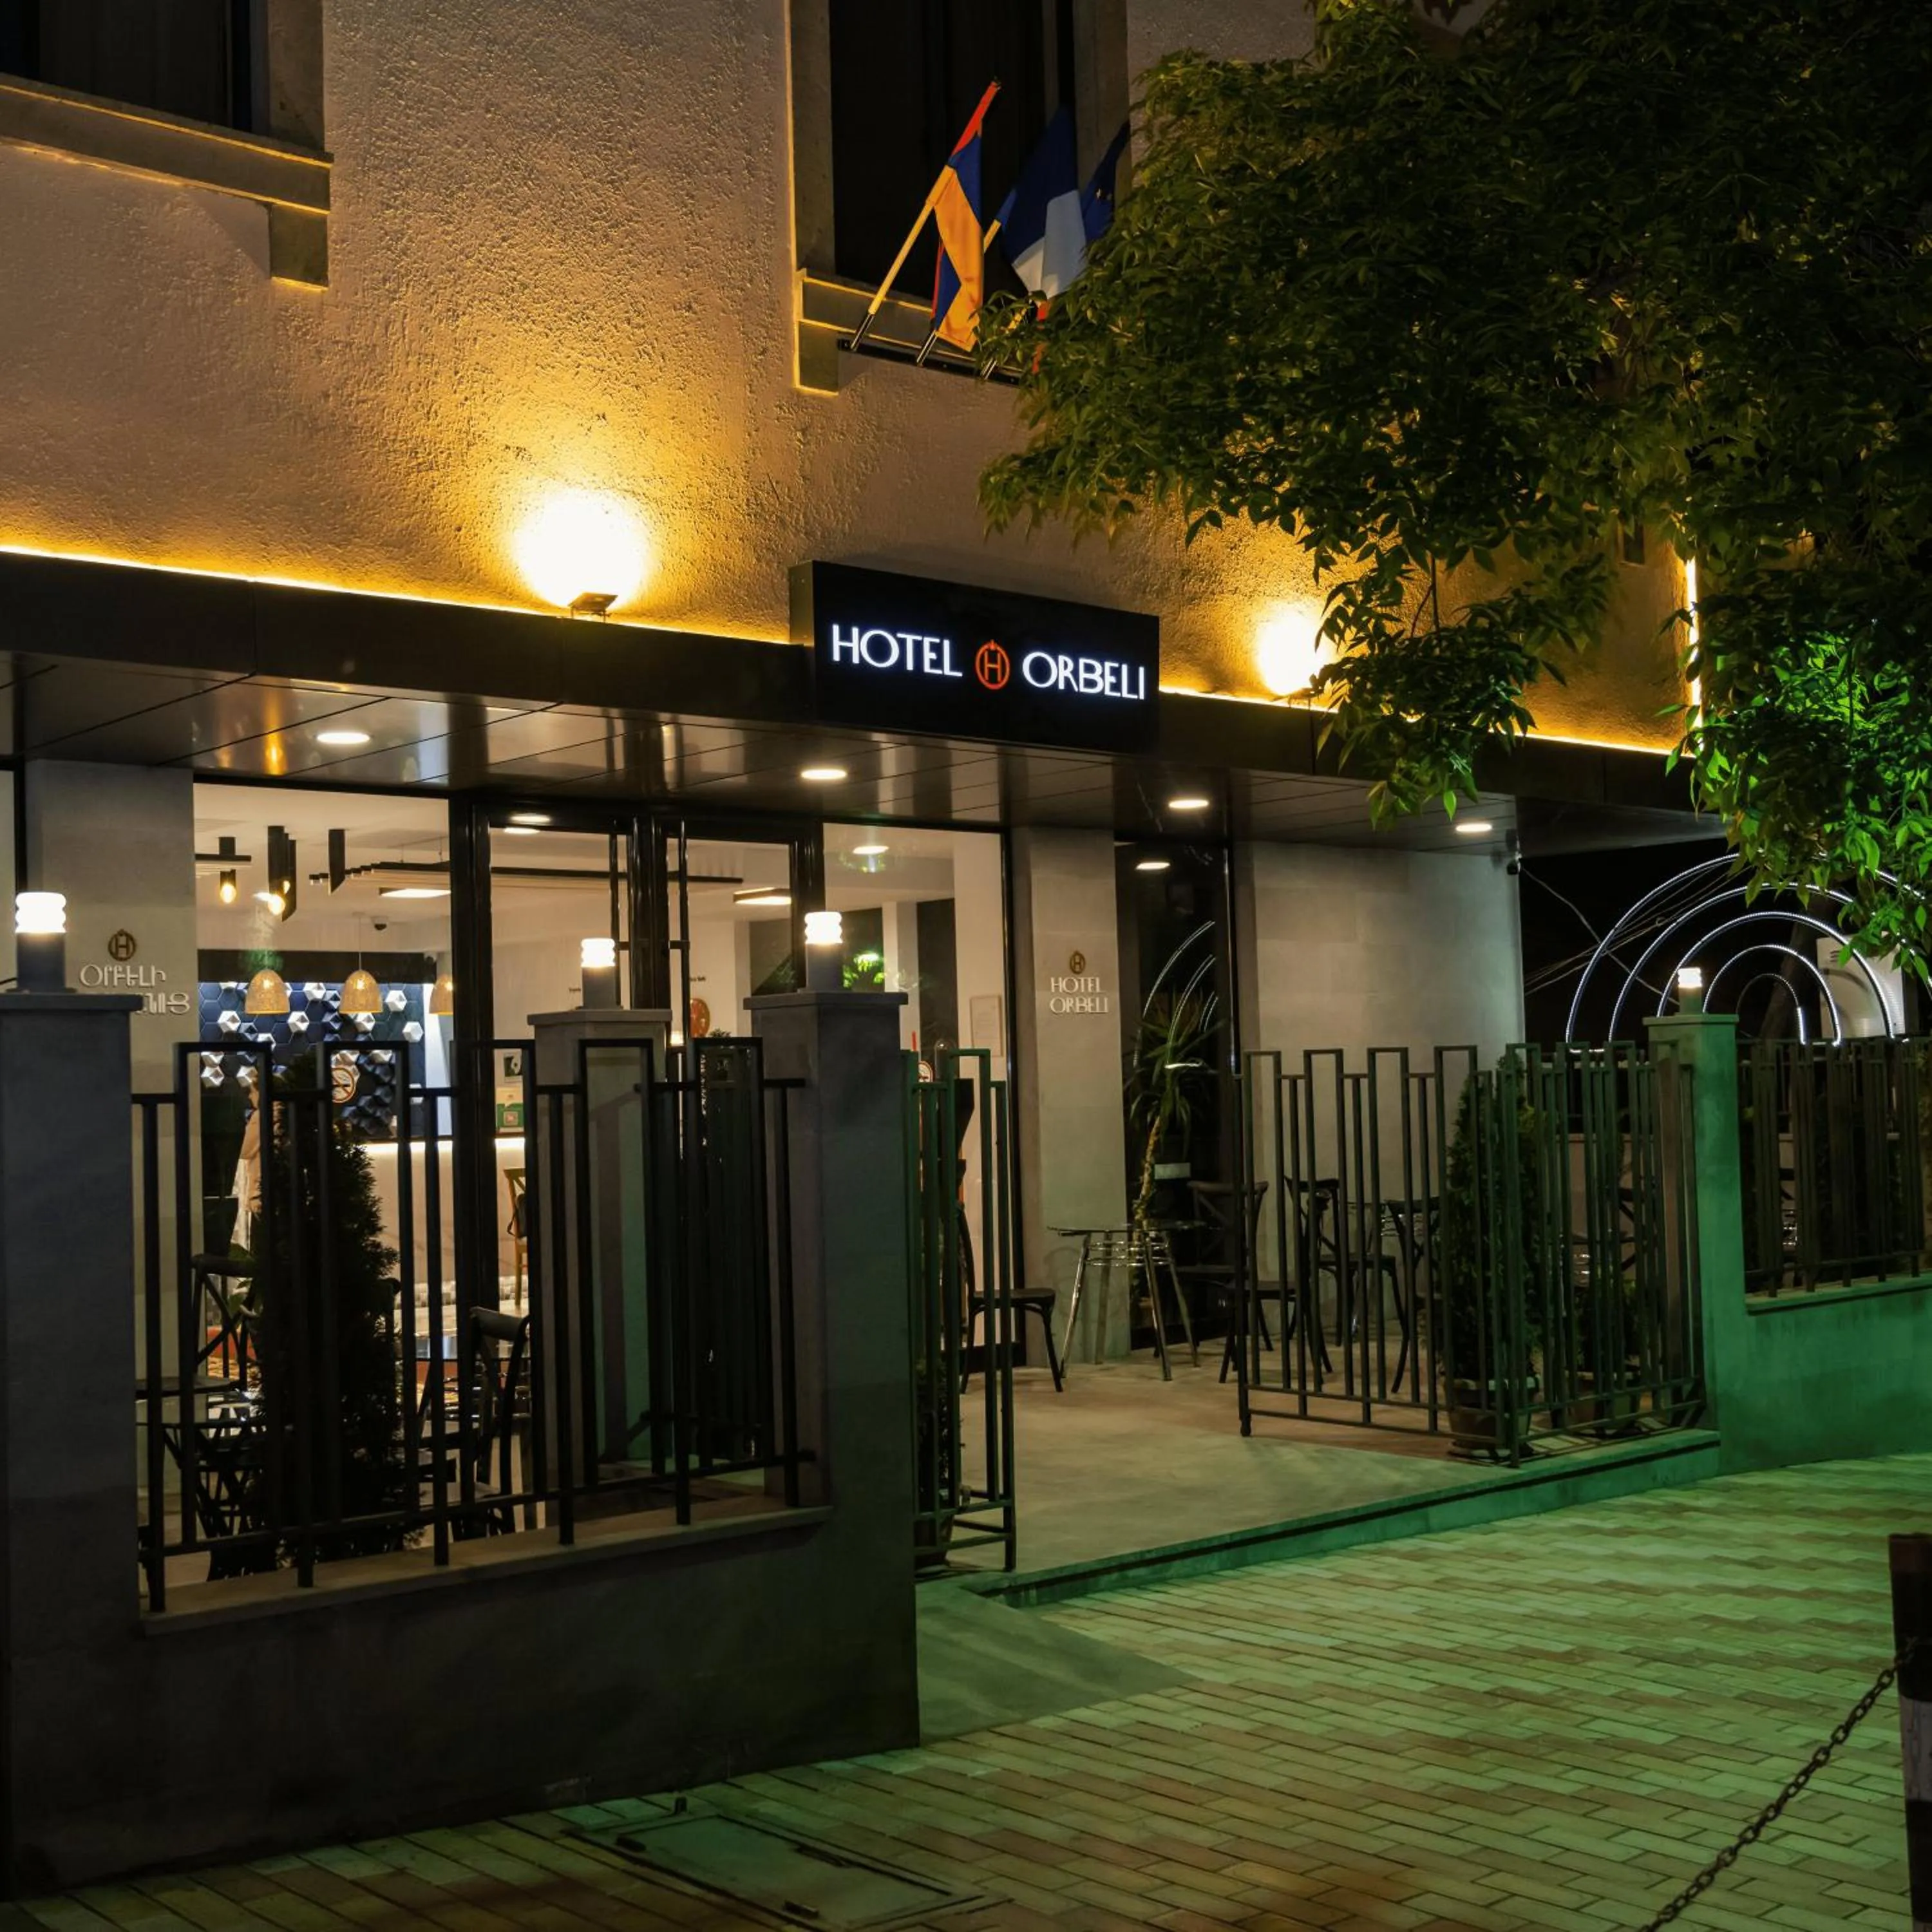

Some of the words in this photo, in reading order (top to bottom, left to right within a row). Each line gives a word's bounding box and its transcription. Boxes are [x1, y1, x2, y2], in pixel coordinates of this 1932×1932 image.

[832, 623, 963, 677] HOTEL
[1022, 651, 1145, 700] ORBELI
[1050, 976, 1105, 994] HOTEL
[1049, 997, 1109, 1014] ORBELI
